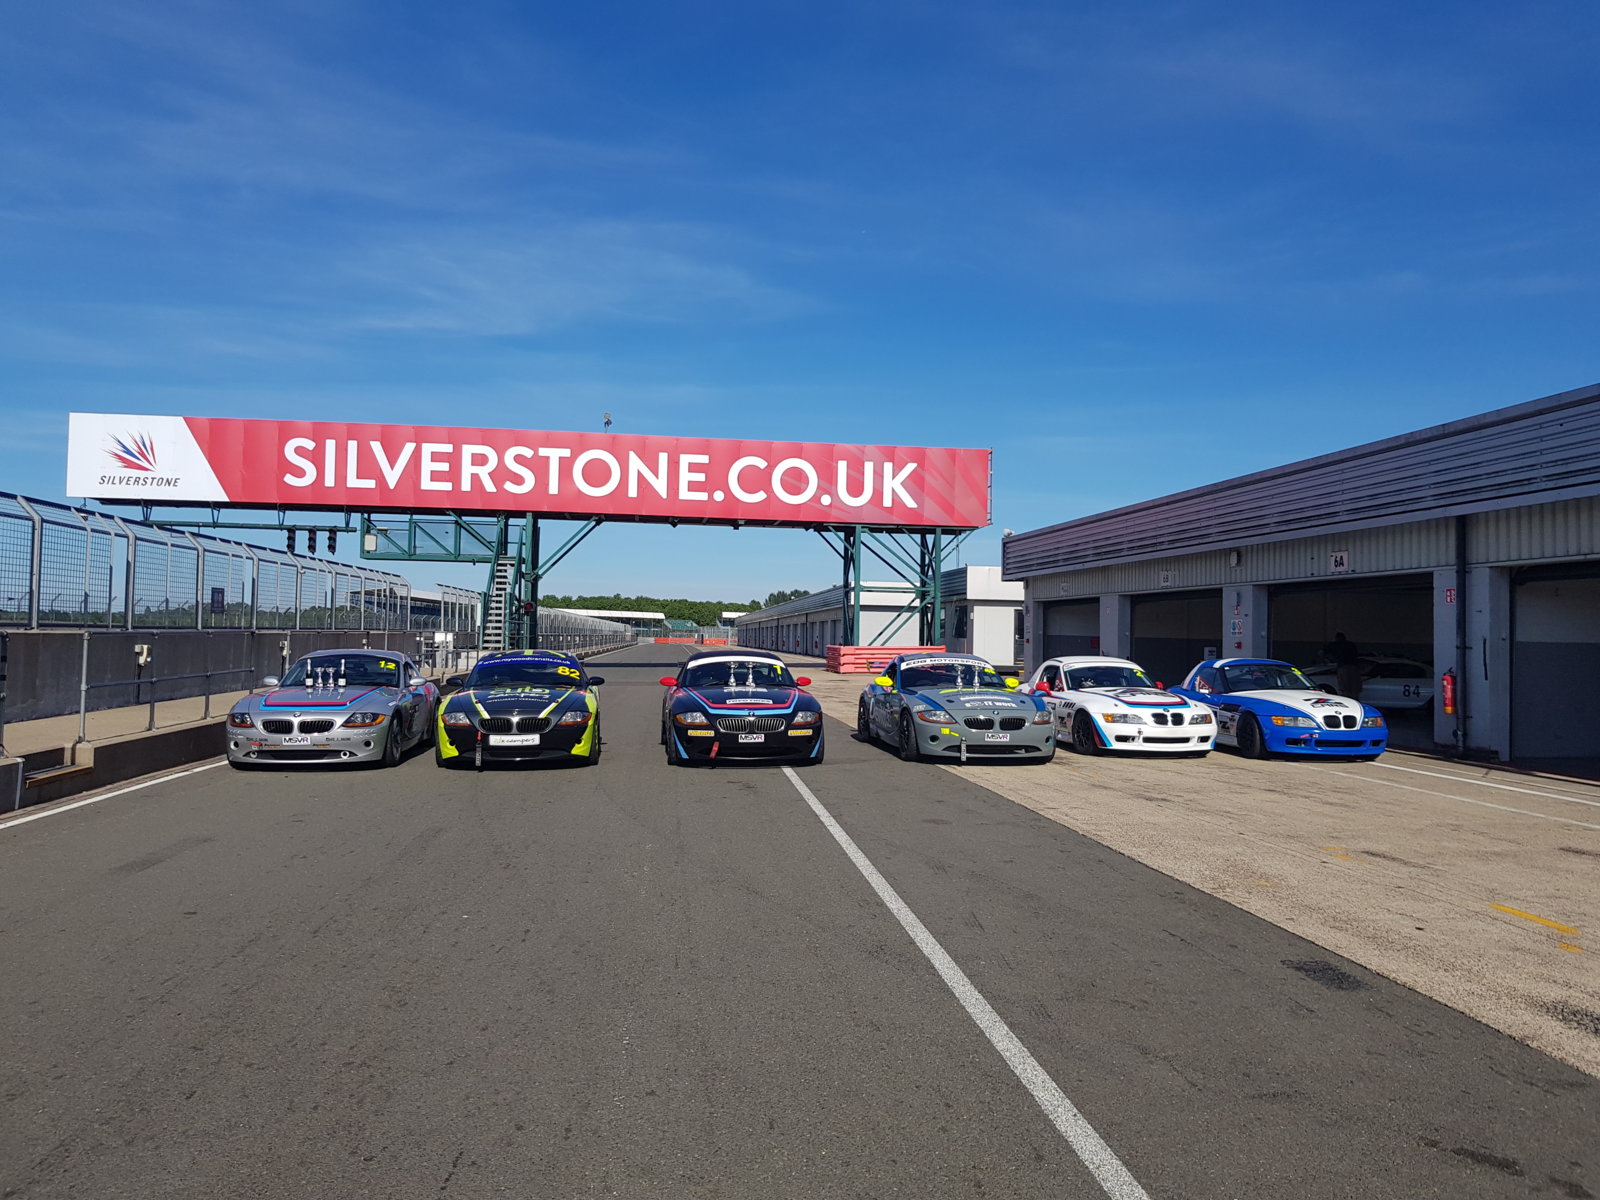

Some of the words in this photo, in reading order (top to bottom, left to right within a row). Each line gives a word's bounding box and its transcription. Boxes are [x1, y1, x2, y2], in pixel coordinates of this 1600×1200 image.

[283, 436, 918, 509] SILVERSTONE.CO.UK
[98, 475, 181, 488] SILVERSTONE
[1334, 555, 1344, 568] 6A
[379, 660, 397, 670] 12
[929, 657, 988, 667] MOTORSPORT
[557, 666, 580, 680] 82
[773, 665, 782, 675] 1
[1403, 684, 1420, 698] 84
